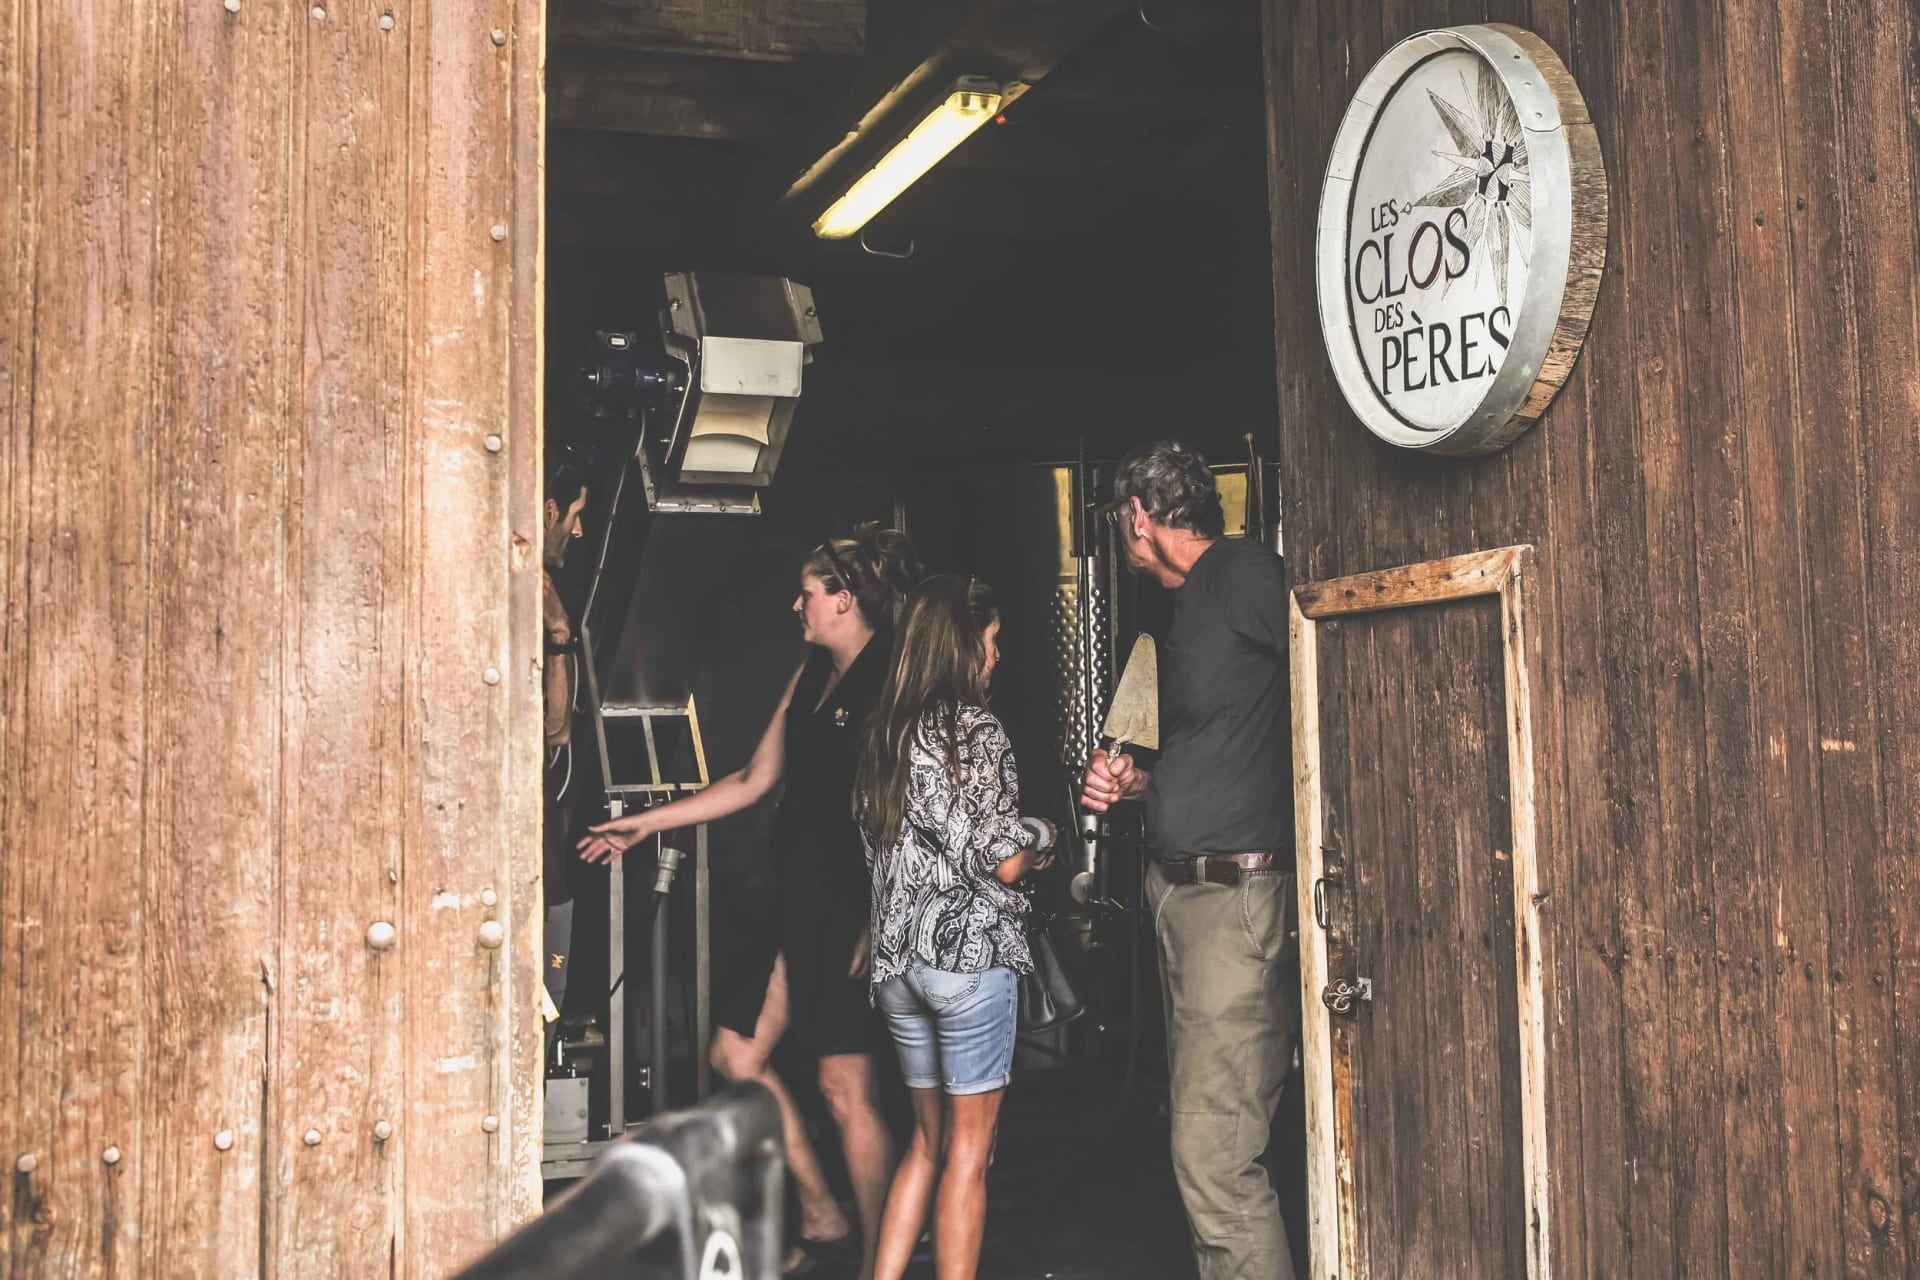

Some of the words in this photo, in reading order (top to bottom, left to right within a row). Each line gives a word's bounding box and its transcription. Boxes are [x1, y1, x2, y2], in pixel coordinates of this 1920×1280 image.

[1371, 199, 1399, 232] LES
[1355, 208, 1470, 304] CLOS
[1374, 302, 1404, 333] DES
[1382, 305, 1511, 395] PÈRES
